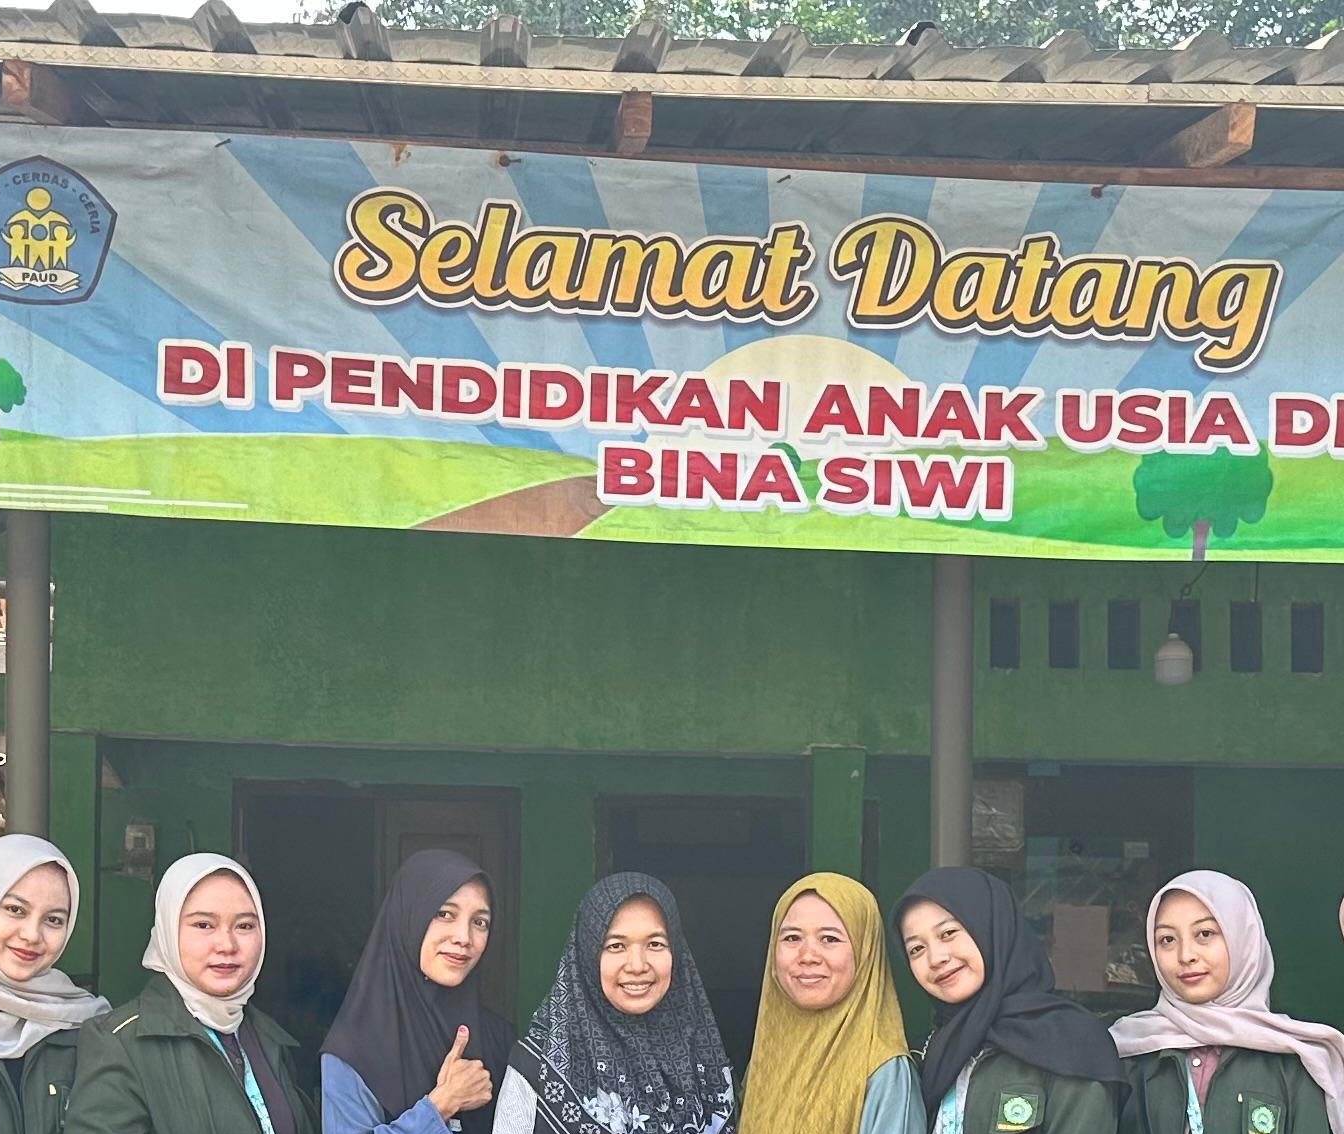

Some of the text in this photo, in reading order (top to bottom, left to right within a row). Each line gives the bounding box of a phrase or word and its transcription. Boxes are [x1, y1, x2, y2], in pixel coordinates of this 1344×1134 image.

[12, 171, 70, 189] CERDAS
[78, 192, 101, 235] CERIA
[22, 272, 58, 283] PAUD
[338, 190, 1280, 369] Selamat Datang
[164, 346, 246, 398] DI
[275, 351, 780, 431] PENDIDIKAN
[804, 384, 1034, 441] ANAK
[1062, 395, 1248, 444] USIA
[604, 447, 1004, 510] BINA SIWI
